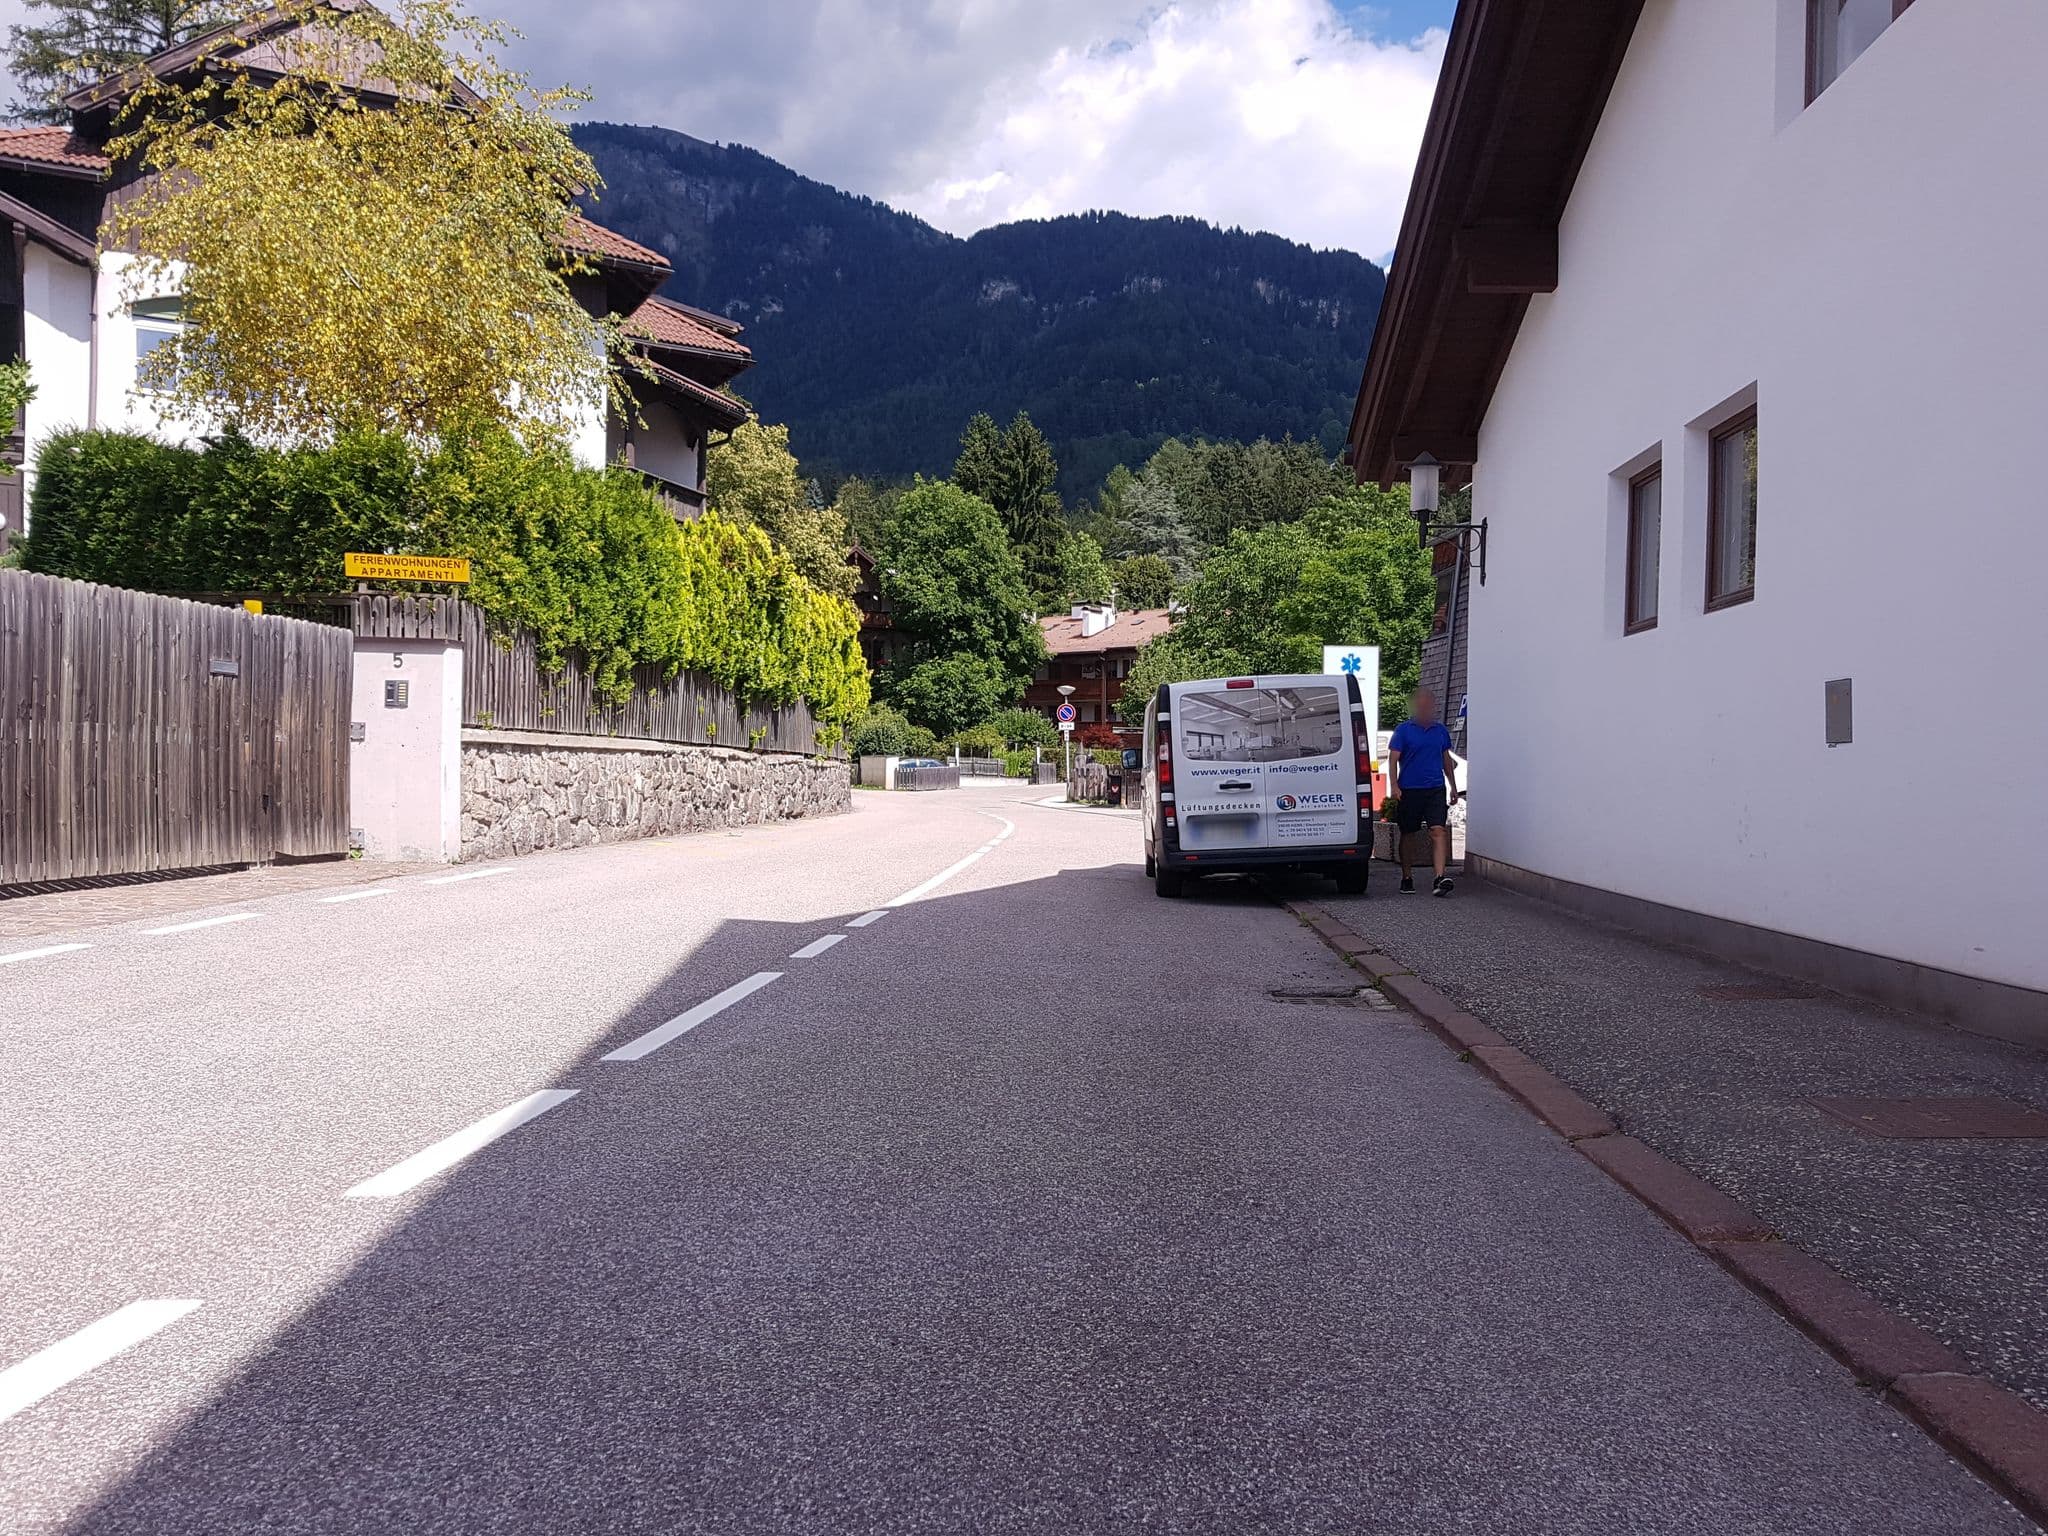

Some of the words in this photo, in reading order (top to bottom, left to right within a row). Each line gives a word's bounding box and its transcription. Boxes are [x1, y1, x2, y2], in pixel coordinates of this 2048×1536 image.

[353, 555, 460, 569] FERIENWOHNUNGEN
[361, 567, 454, 580] APPARTAMENTI
[393, 653, 403, 668] 5
[1191, 766, 1261, 777] www.weger.it
[1269, 764, 1338, 775] info@weger.it
[1298, 794, 1344, 803] WEGER
[1181, 802, 1261, 812] Lüftungsdecken
